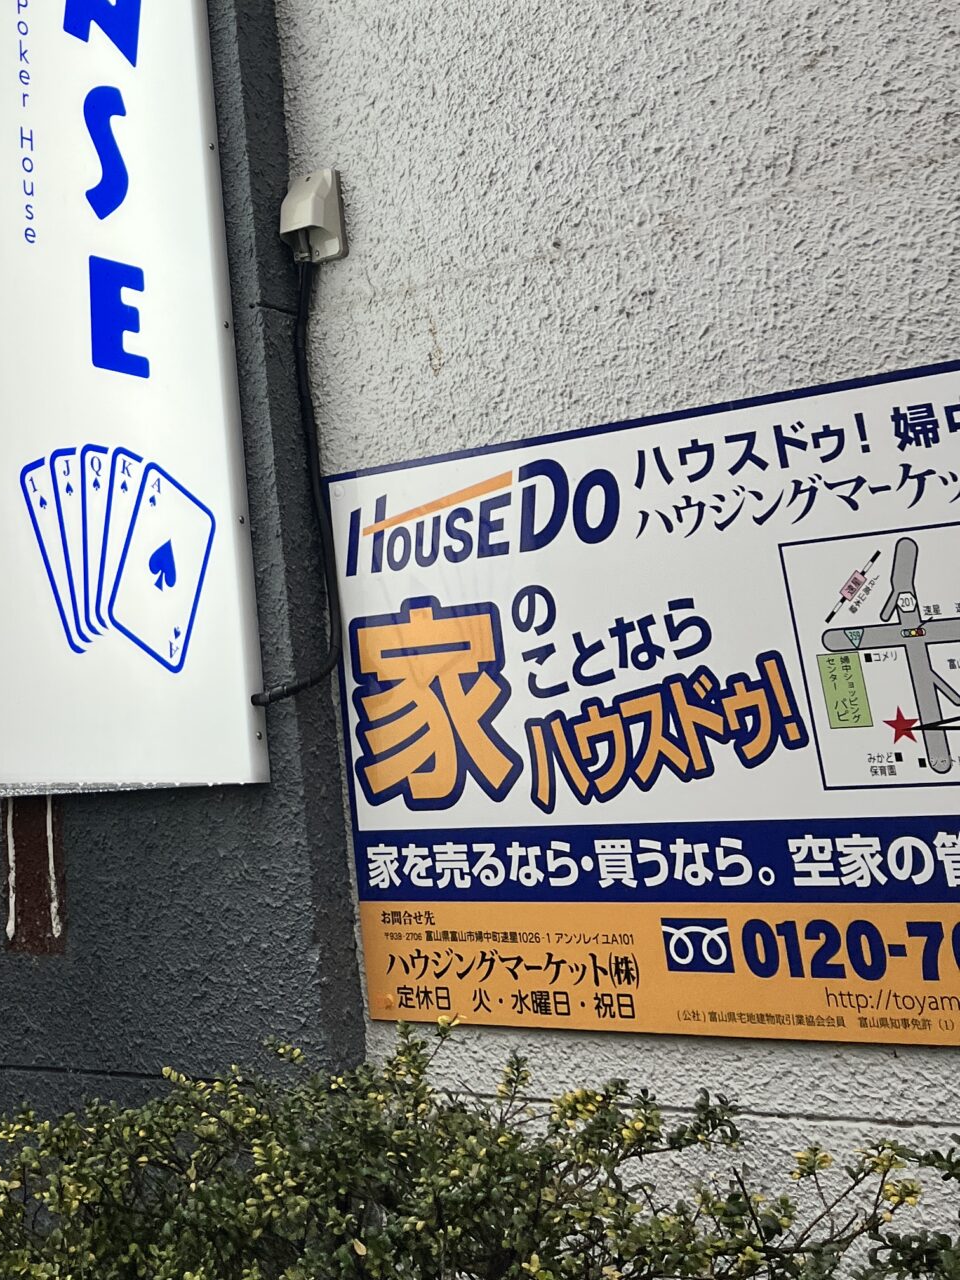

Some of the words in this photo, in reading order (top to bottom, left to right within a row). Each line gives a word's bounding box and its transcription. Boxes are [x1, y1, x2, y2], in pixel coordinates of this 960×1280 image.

[19, 126, 36, 244] House
[63, 460, 71, 476] J
[90, 456, 102, 477] Q
[120, 459, 132, 478] K
[150, 477, 161, 494] A
[512, 585, 557, 636] の
[899, 597, 914, 608] 201
[522, 597, 714, 699] ことなら
[848, 630, 861, 641] 359
[873, 651, 898, 662] コメリ
[351, 597, 521, 810] 家
[840, 656, 862, 723] 婦中ショッピング
[867, 752, 894, 764] みかど
[870, 765, 897, 777] 保育園
[381, 910, 436, 926] お問合せ先
[741, 918, 960, 981] 0120-7
[396, 984, 451, 1010] 定休日
